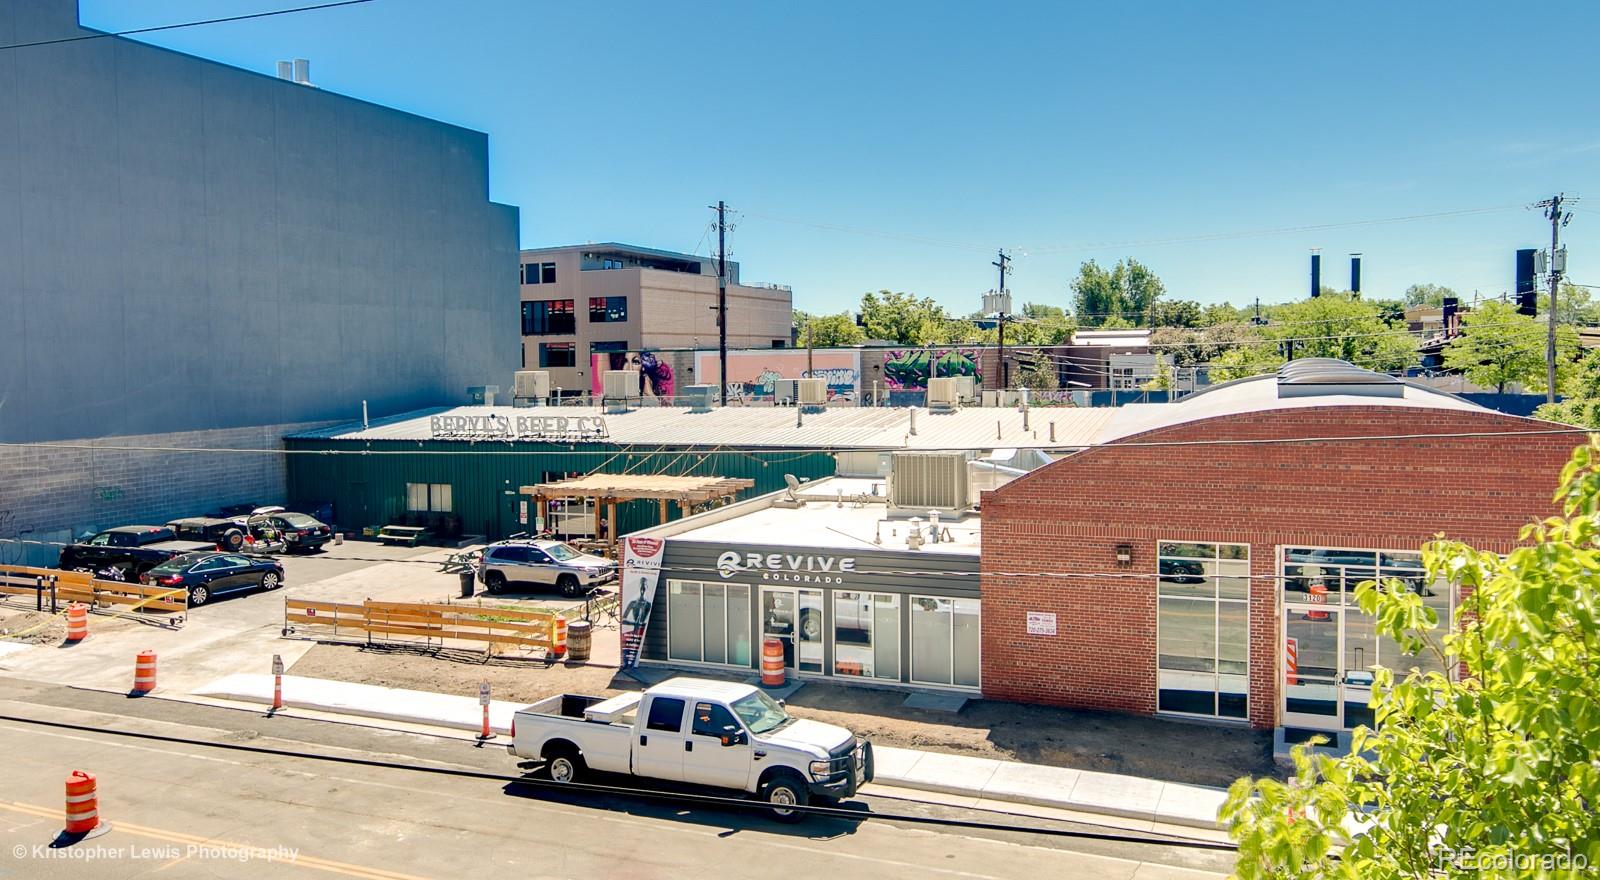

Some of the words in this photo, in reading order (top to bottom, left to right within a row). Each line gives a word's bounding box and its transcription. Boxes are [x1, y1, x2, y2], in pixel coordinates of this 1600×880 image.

[516, 416, 569, 433] BEER
[746, 553, 856, 572] REVIVE
[762, 573, 842, 584] COLORADO
